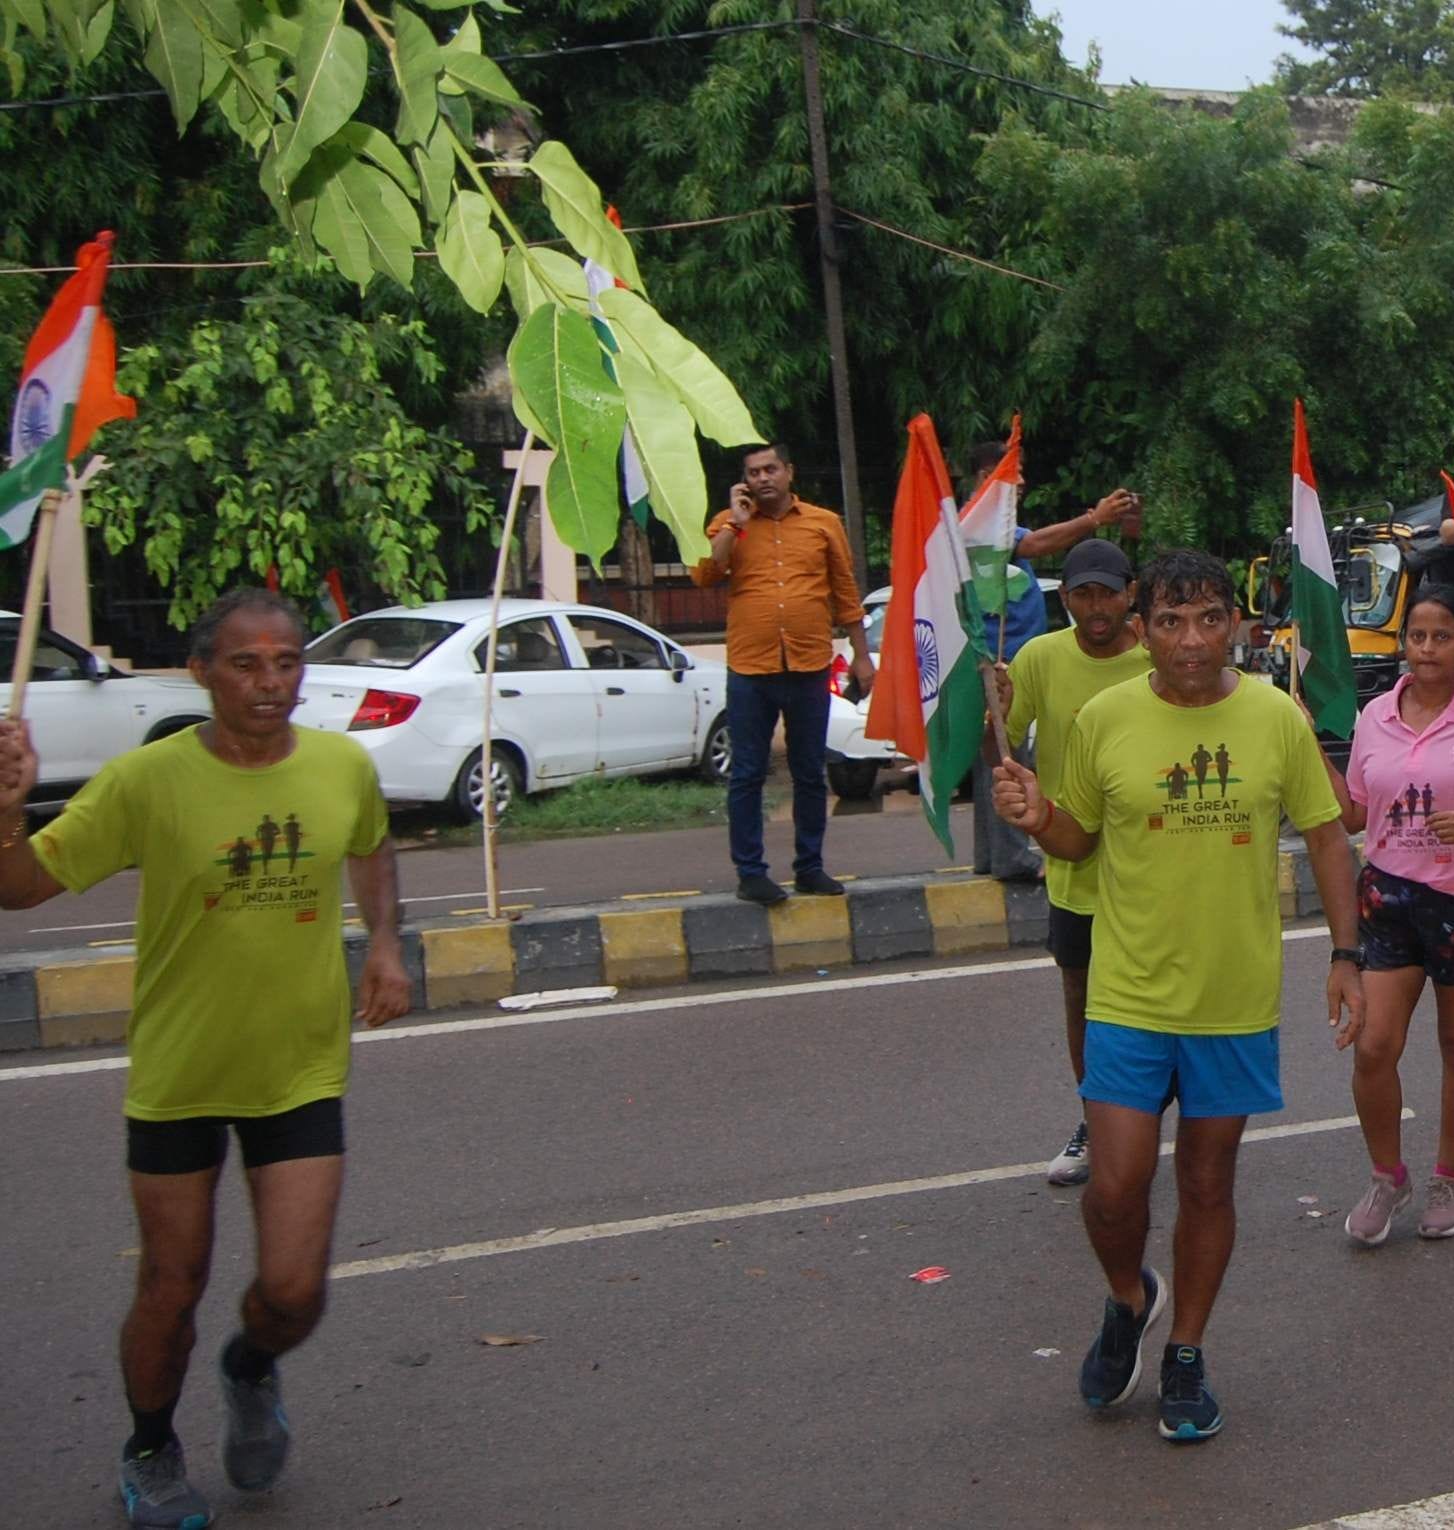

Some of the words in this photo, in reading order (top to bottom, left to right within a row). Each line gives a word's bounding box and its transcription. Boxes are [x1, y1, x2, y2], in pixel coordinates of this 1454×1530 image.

[1162, 802, 1189, 814] THE
[1193, 799, 1239, 813] GREAT
[1182, 813, 1221, 826] INDIA
[1224, 812, 1251, 824] RUN
[1386, 829, 1402, 838] THE
[1405, 828, 1434, 838] GREA
[1397, 839, 1425, 848] INDIA
[223, 879, 251, 892] THE
[256, 874, 309, 889] GREAT
[241, 890, 285, 904] INDIA
[289, 887, 319, 901] RUN
